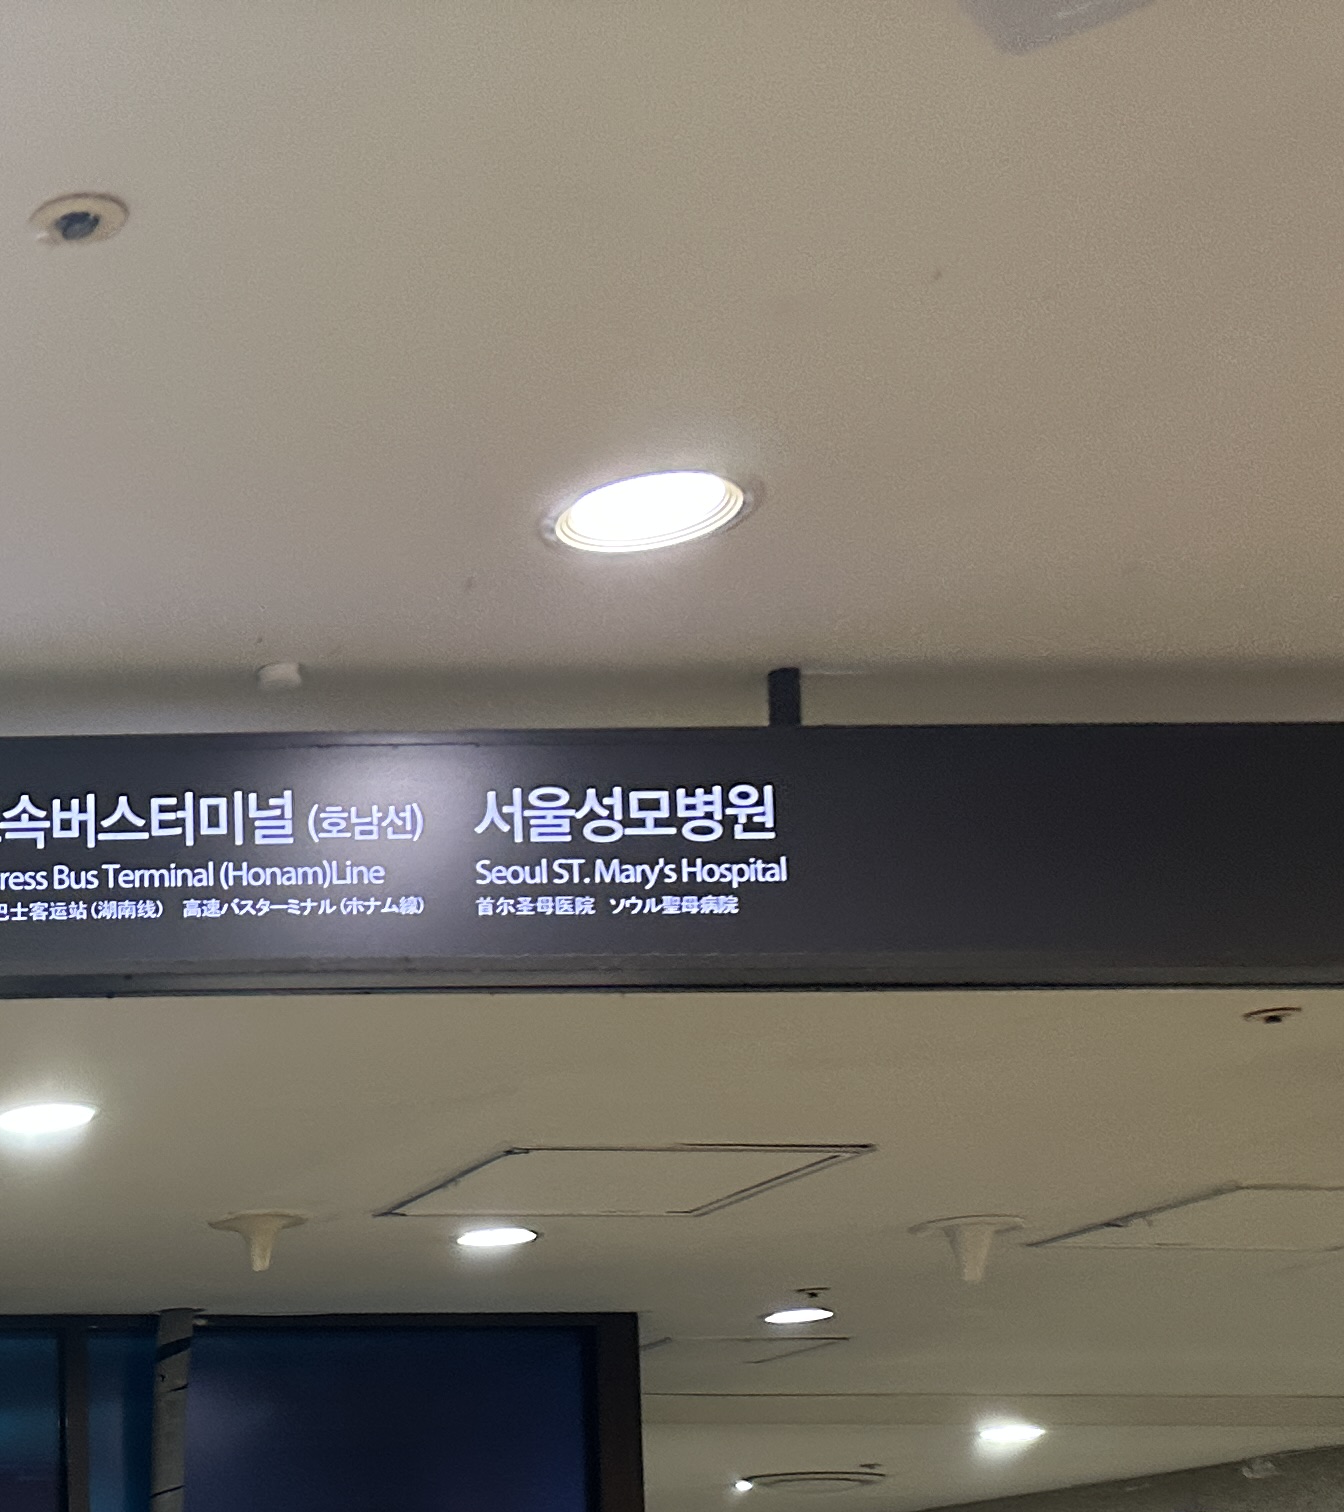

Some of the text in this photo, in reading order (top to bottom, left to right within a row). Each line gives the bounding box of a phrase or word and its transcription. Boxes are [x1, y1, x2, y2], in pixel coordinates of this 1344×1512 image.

[308, 801, 424, 843] (호남선)
[475, 784, 776, 844] 서울성모병원
[53, 864, 99, 890] Bus
[102, 860, 215, 889] Terminal
[220, 858, 386, 891] (Honam)Line
[475, 856, 788, 891] Seoul ST. Mary's Hospital
[475, 896, 596, 917] 首尔圣母医院
